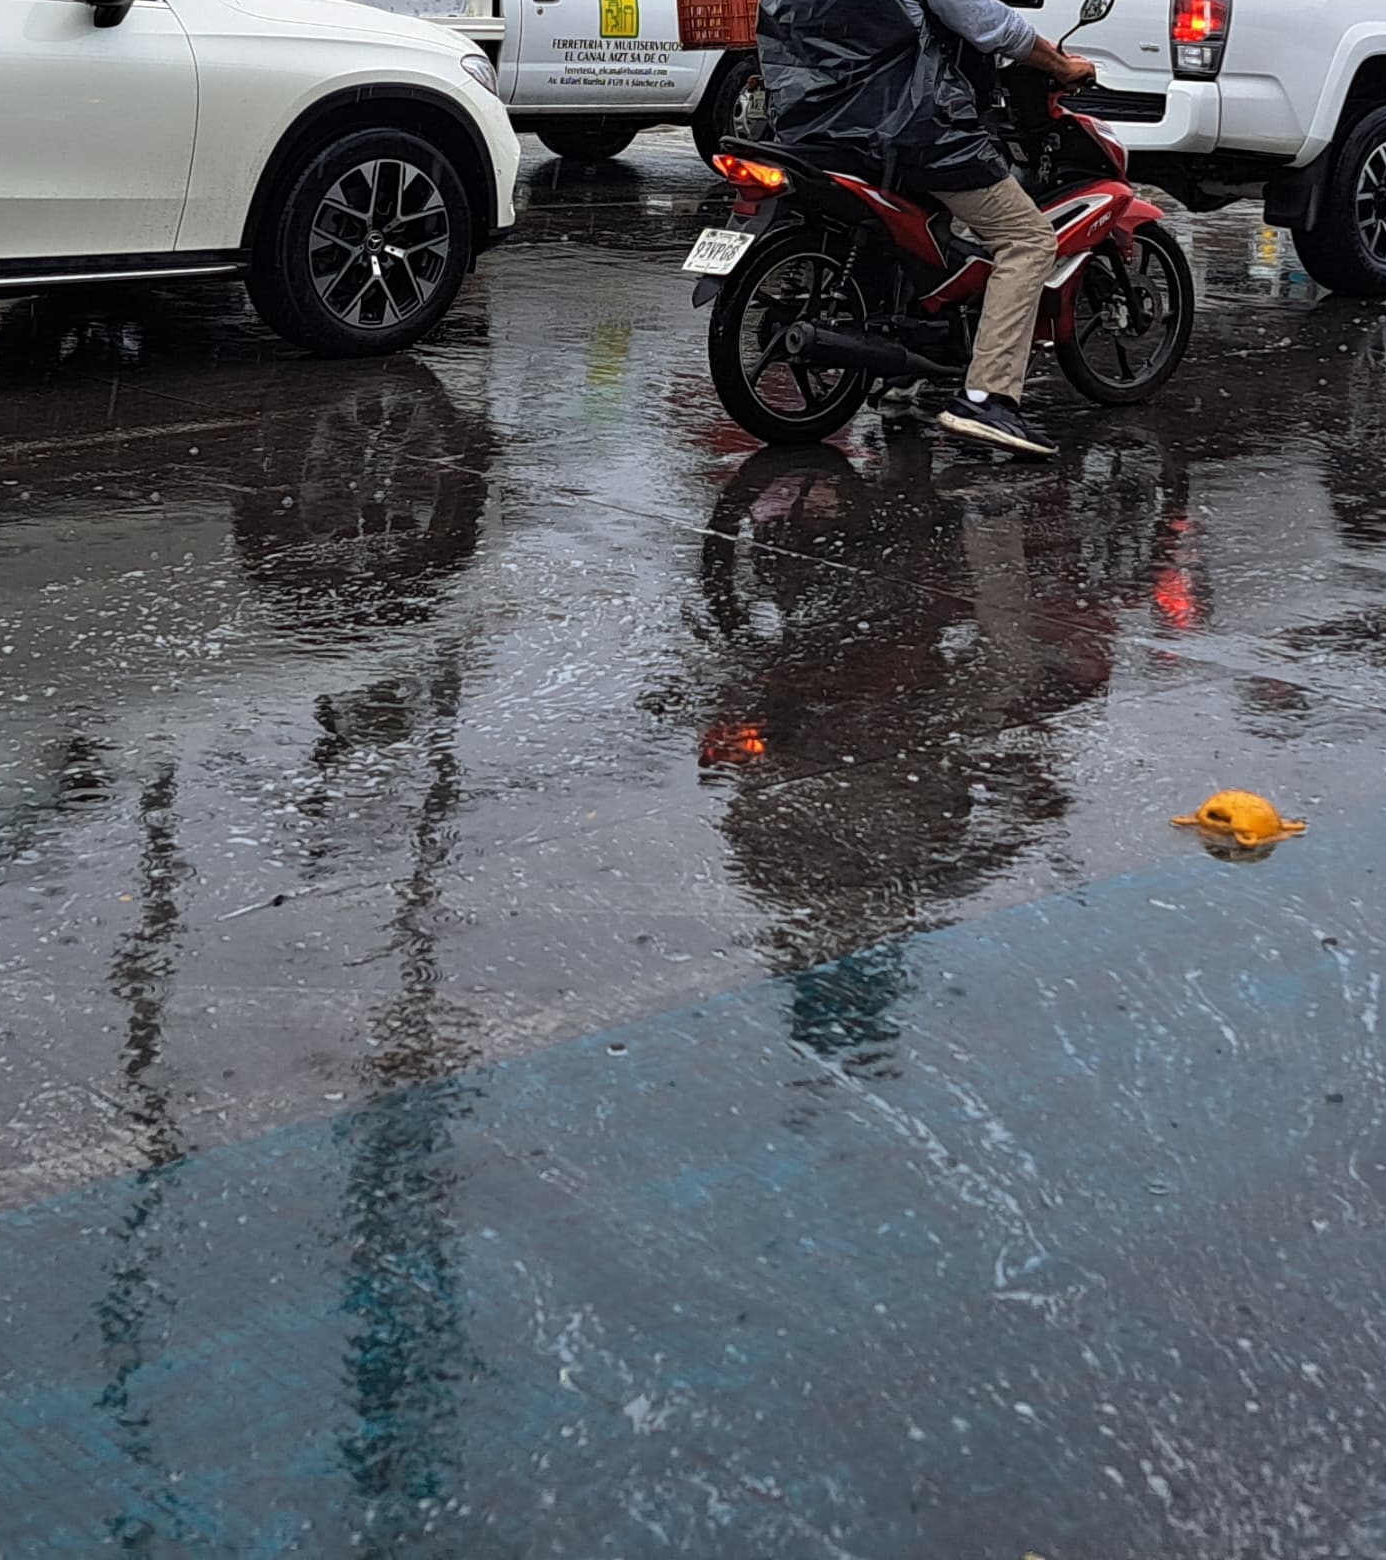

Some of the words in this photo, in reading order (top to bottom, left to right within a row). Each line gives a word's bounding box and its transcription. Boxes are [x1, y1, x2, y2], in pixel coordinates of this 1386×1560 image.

[553, 38, 603, 50] FERRETERIA
[606, 39, 612, 50] Y
[565, 51, 574, 62] EL
[577, 51, 606, 62] CANAL
[609, 52, 628, 63] MZT
[629, 53, 641, 63] SA
[644, 53, 656, 63] DE
[658, 54, 670, 64] CV
